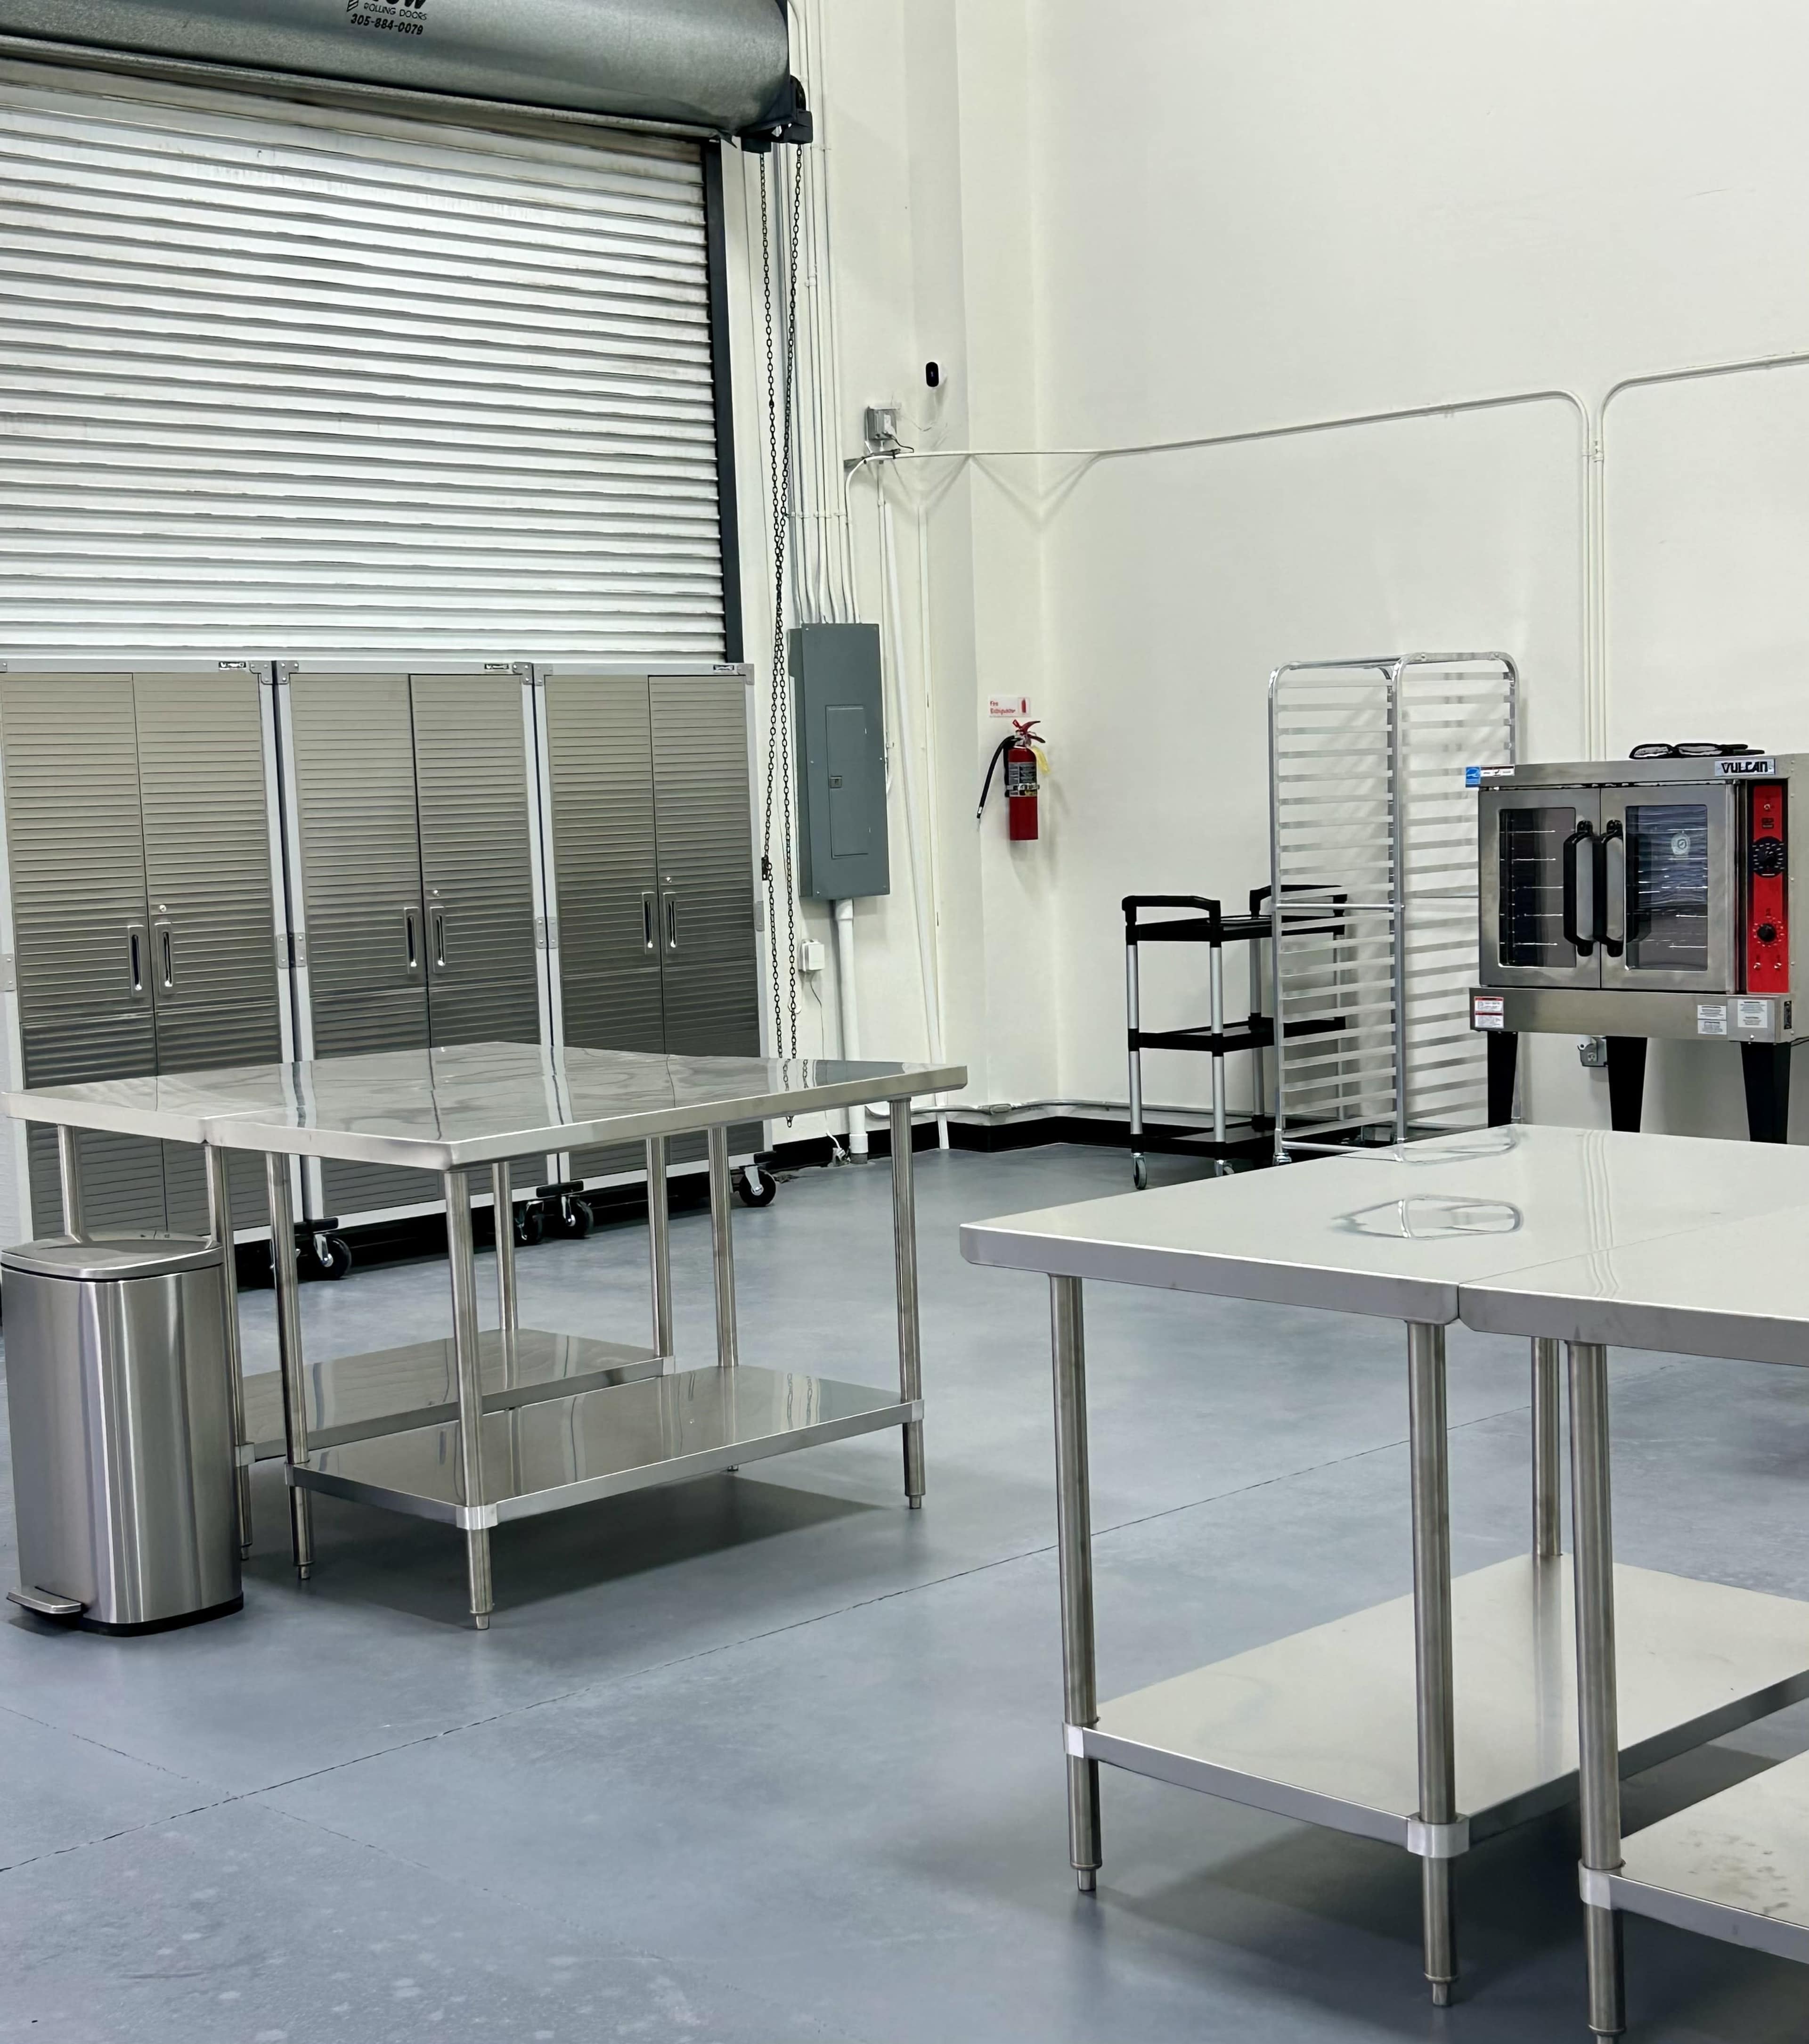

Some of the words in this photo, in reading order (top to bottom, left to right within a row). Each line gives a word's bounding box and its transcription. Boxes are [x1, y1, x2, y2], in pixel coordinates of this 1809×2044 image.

[364, 2, 396, 15] ROLLING
[350, 13, 423, 35] 305-884-0079
[1721, 761, 1768, 773] VULCAN
